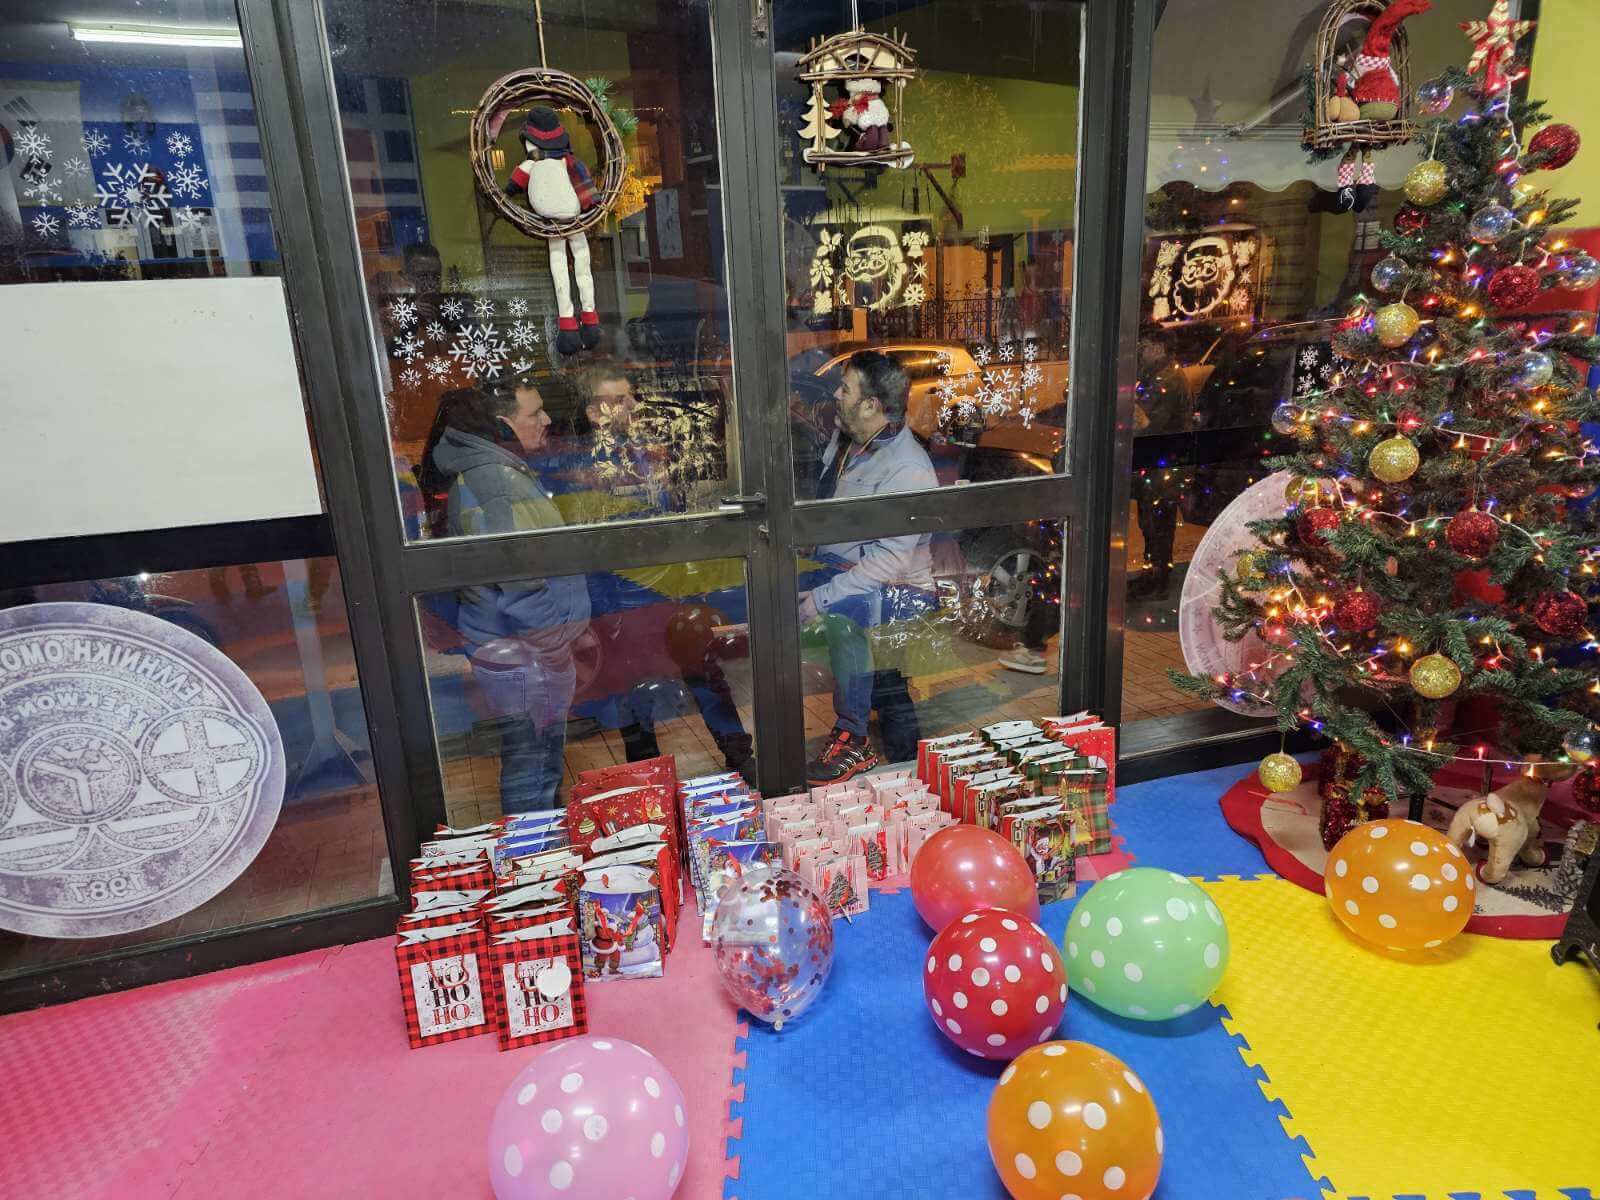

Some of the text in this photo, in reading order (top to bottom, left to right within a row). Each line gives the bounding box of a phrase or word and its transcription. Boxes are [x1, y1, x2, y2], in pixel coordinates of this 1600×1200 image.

[431, 983, 470, 1008] HO
[432, 1003, 471, 1026] HO
[522, 1004, 560, 1027] HO
